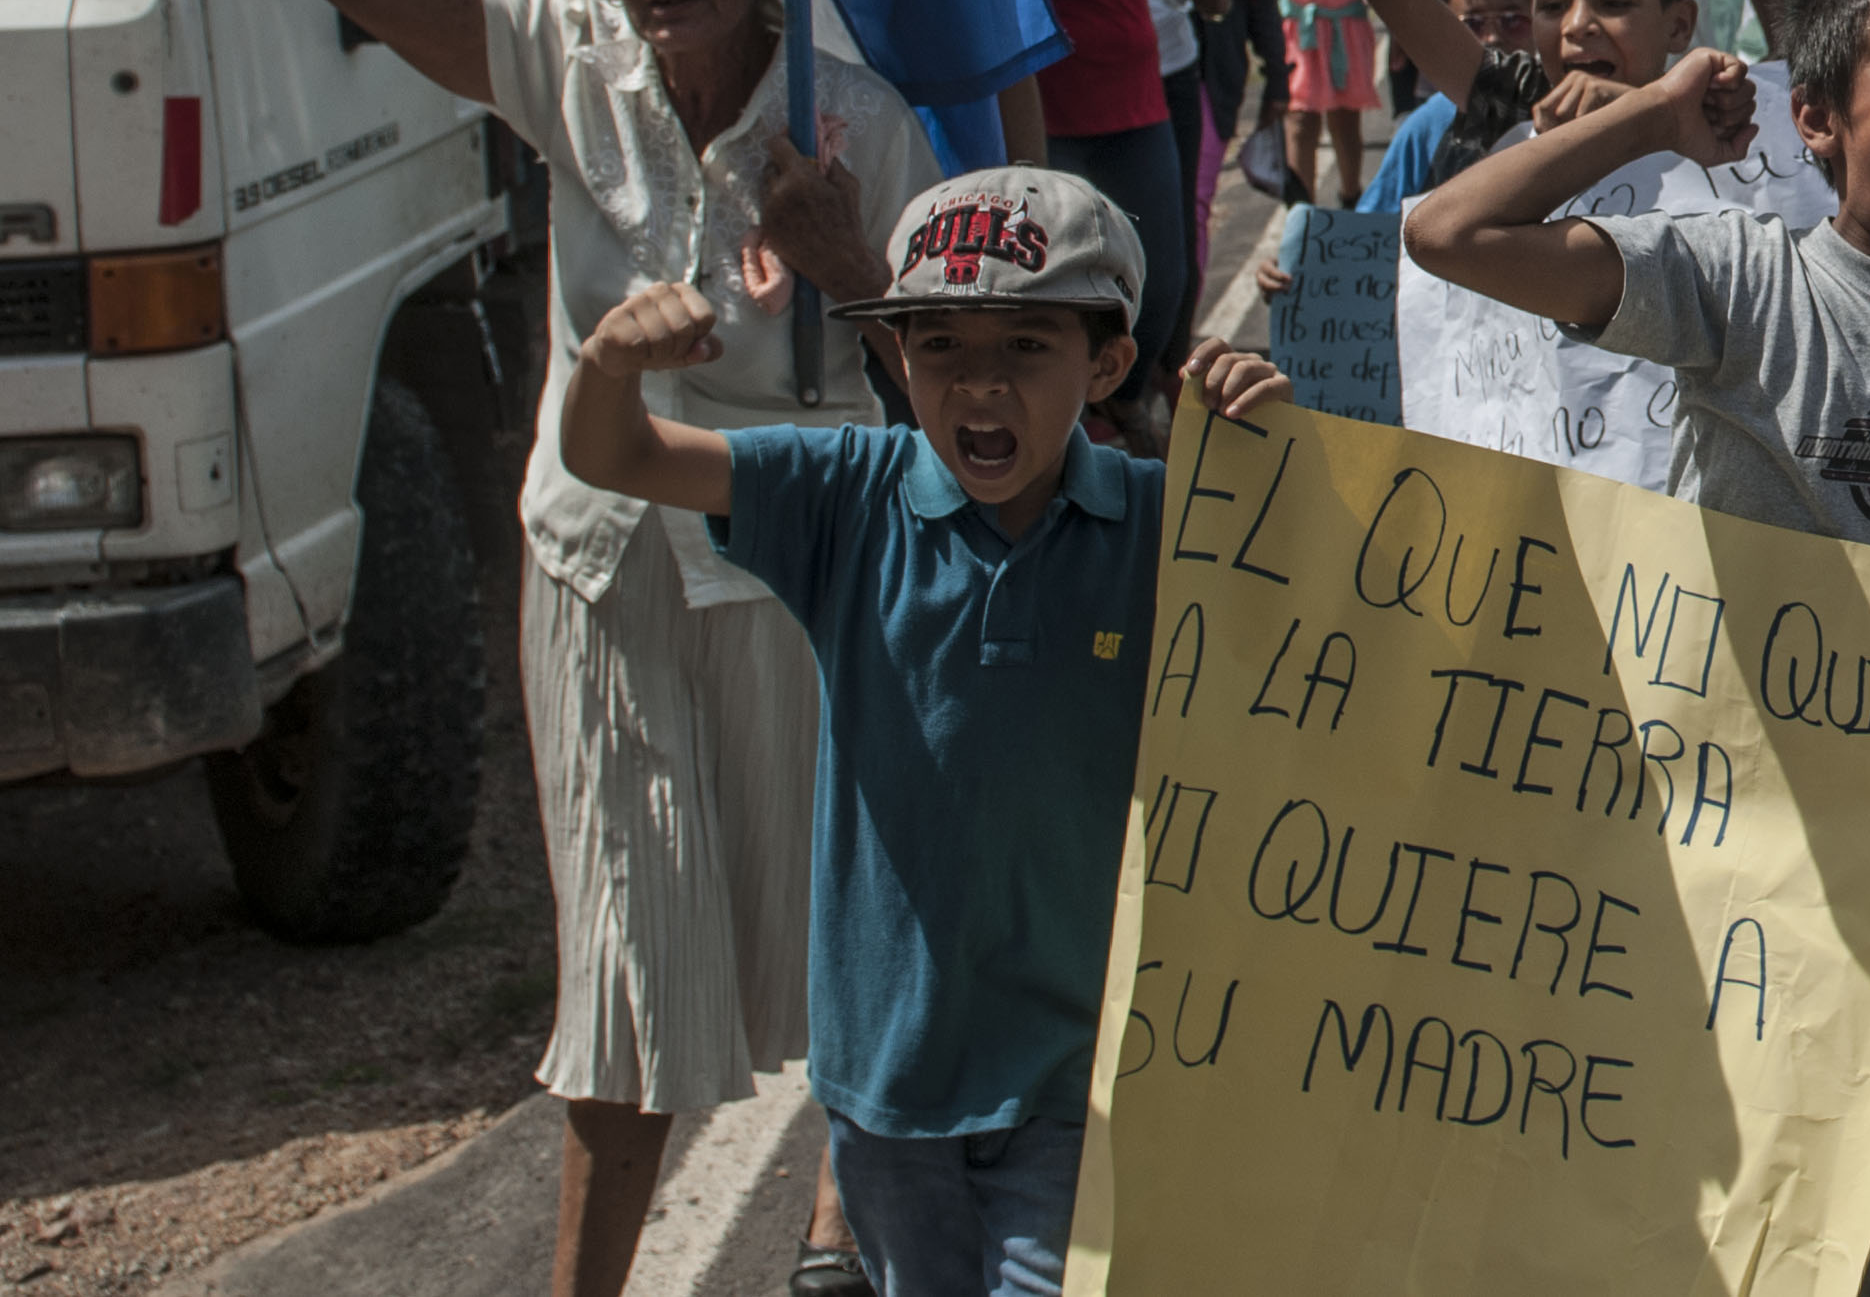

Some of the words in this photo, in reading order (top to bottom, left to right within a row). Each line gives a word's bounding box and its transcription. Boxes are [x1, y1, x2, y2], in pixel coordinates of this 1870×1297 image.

[262, 159, 327, 200] DIESEL
[938, 192, 1015, 211] CHICAGO
[898, 203, 1049, 283] BULLS
[1173, 410, 1296, 586] EL
[1355, 468, 1558, 638] QUE
[1604, 562, 1726, 699] NO
[1092, 631, 1124, 660] CAT
[1152, 602, 1205, 718] A
[1249, 618, 1357, 731] LA
[1428, 668, 1734, 848] TIERRA
[1249, 798, 1643, 1000] QUIERE
[1706, 917, 1768, 1043] A
[1302, 998, 1637, 1161] MADRE
